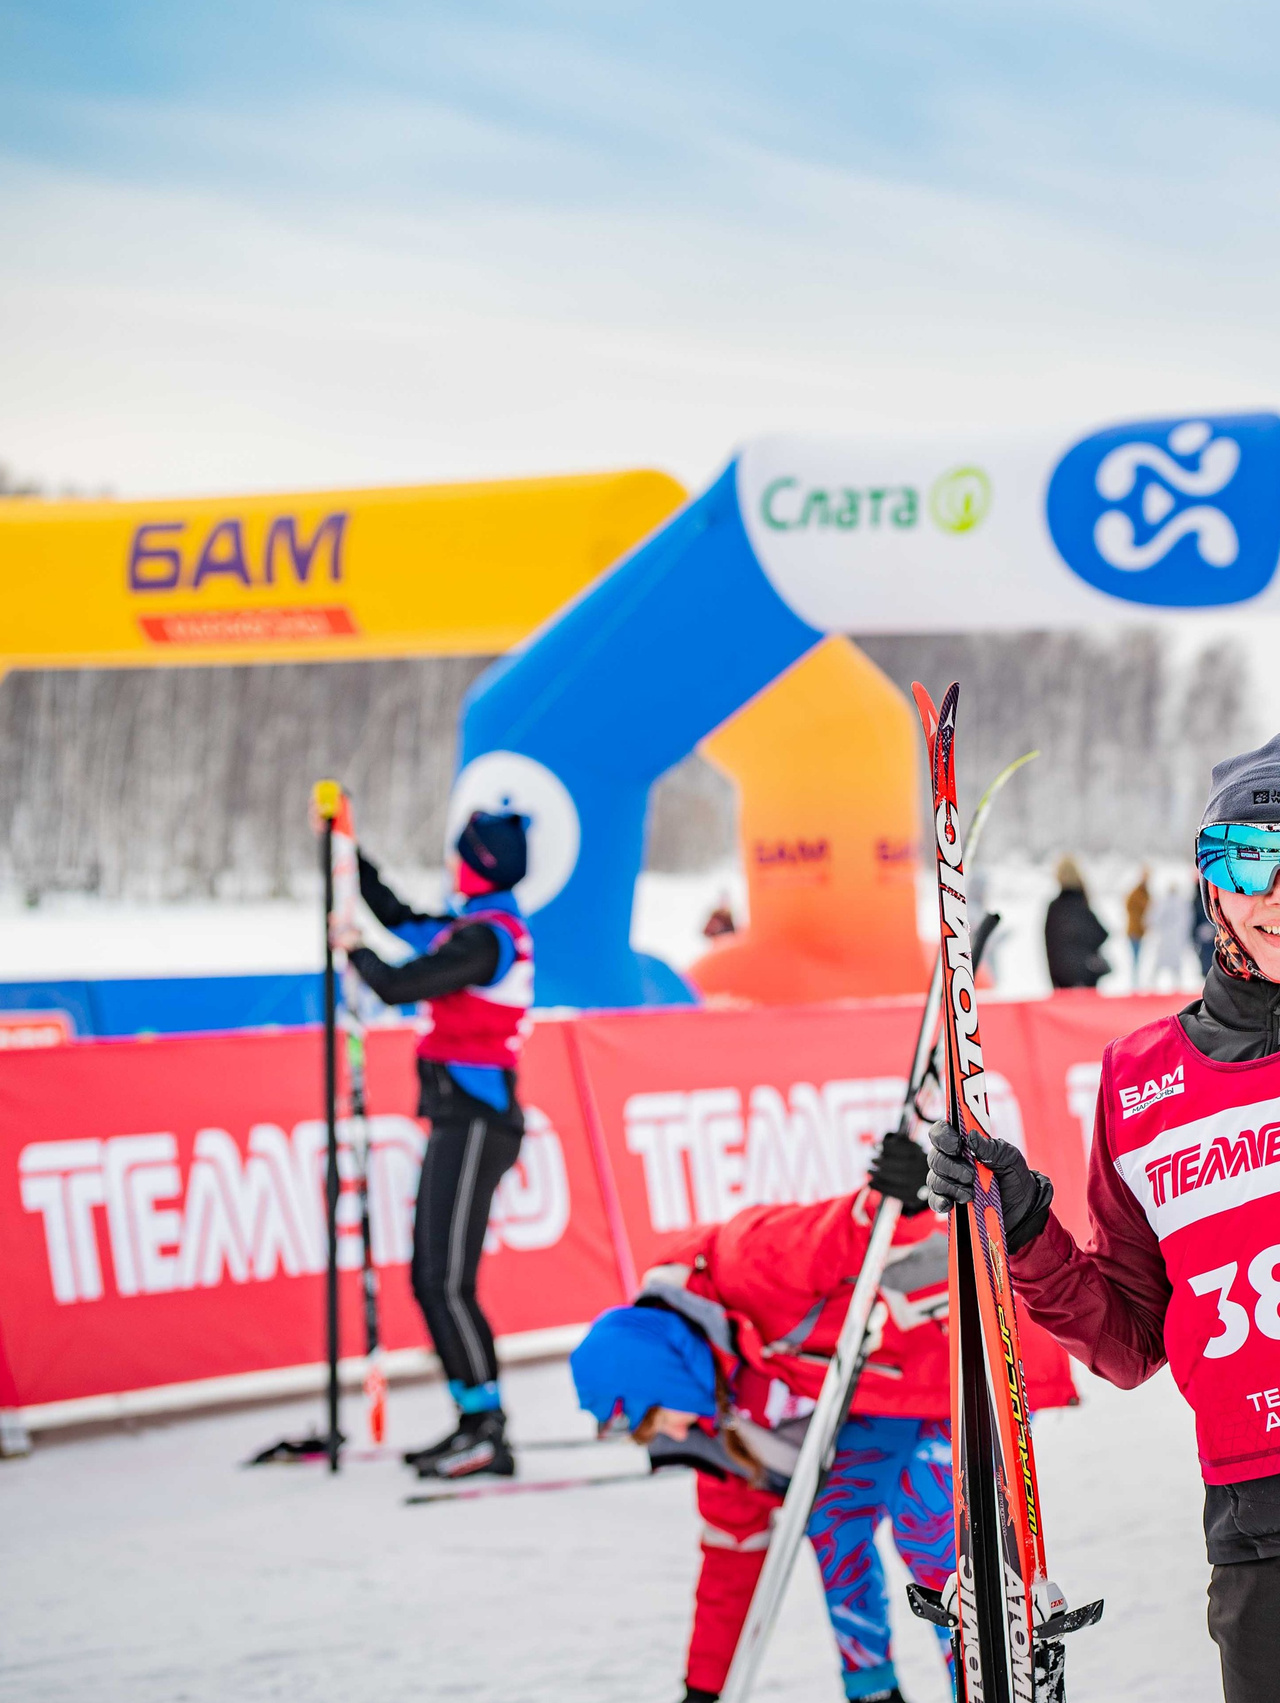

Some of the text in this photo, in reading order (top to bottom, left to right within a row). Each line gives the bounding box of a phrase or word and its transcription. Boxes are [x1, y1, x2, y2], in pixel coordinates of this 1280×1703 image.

[759, 476, 919, 533] Слата
[127, 512, 350, 592] БАМ
[936, 798, 992, 1140] ATOMIC
[1119, 1064, 1184, 1109] БАМ
